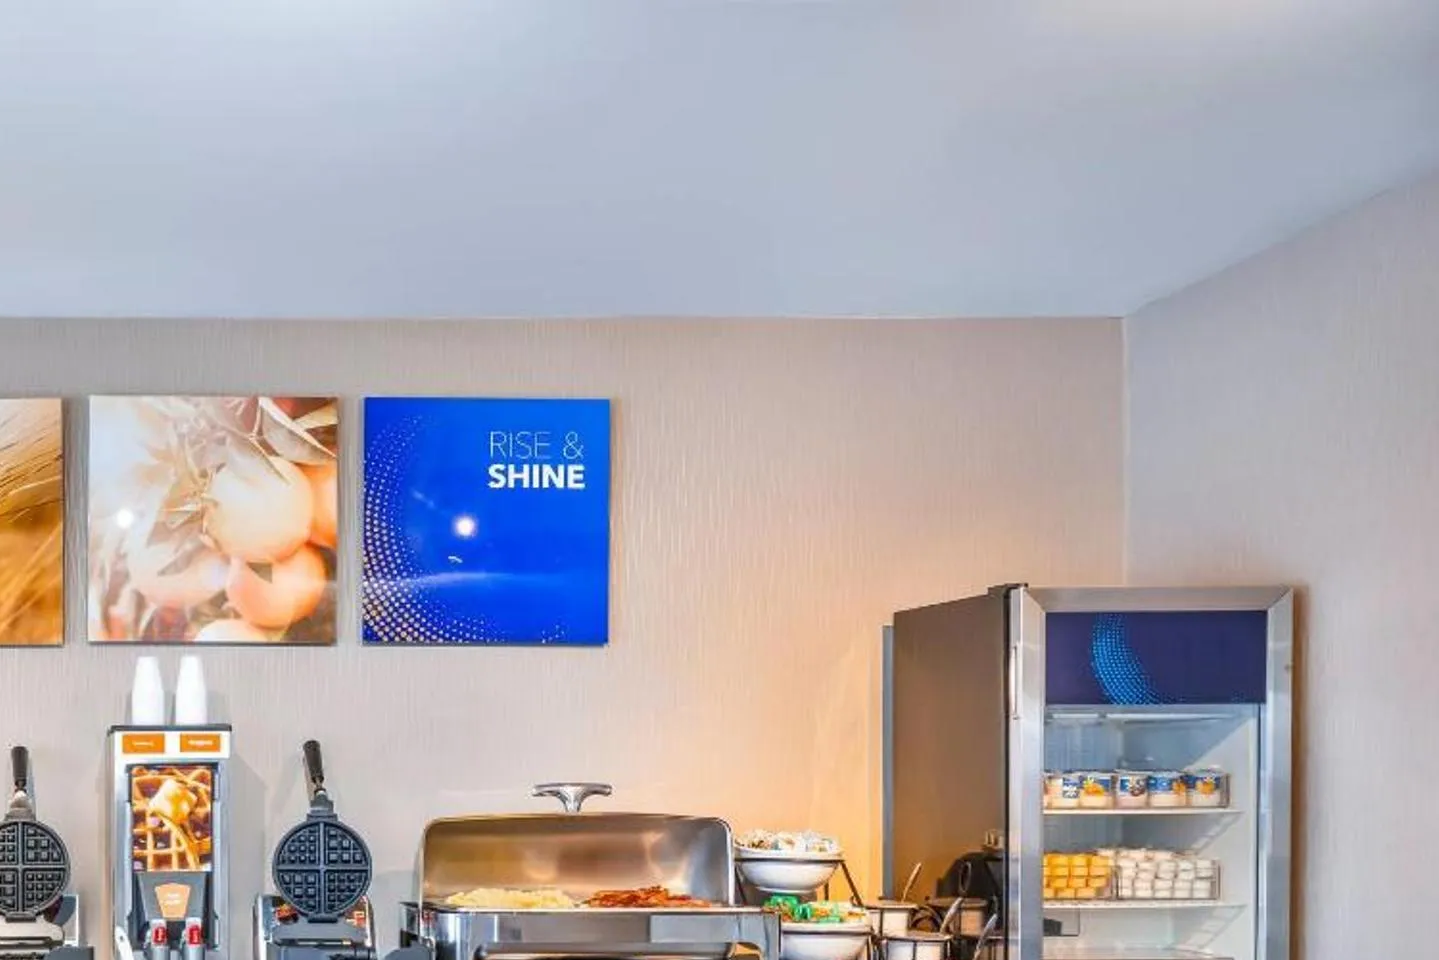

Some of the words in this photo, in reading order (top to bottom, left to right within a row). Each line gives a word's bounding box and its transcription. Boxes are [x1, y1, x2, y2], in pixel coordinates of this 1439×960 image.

[489, 431, 551, 459] RISE
[563, 431, 584, 459] &
[488, 463, 585, 489] SHINE
